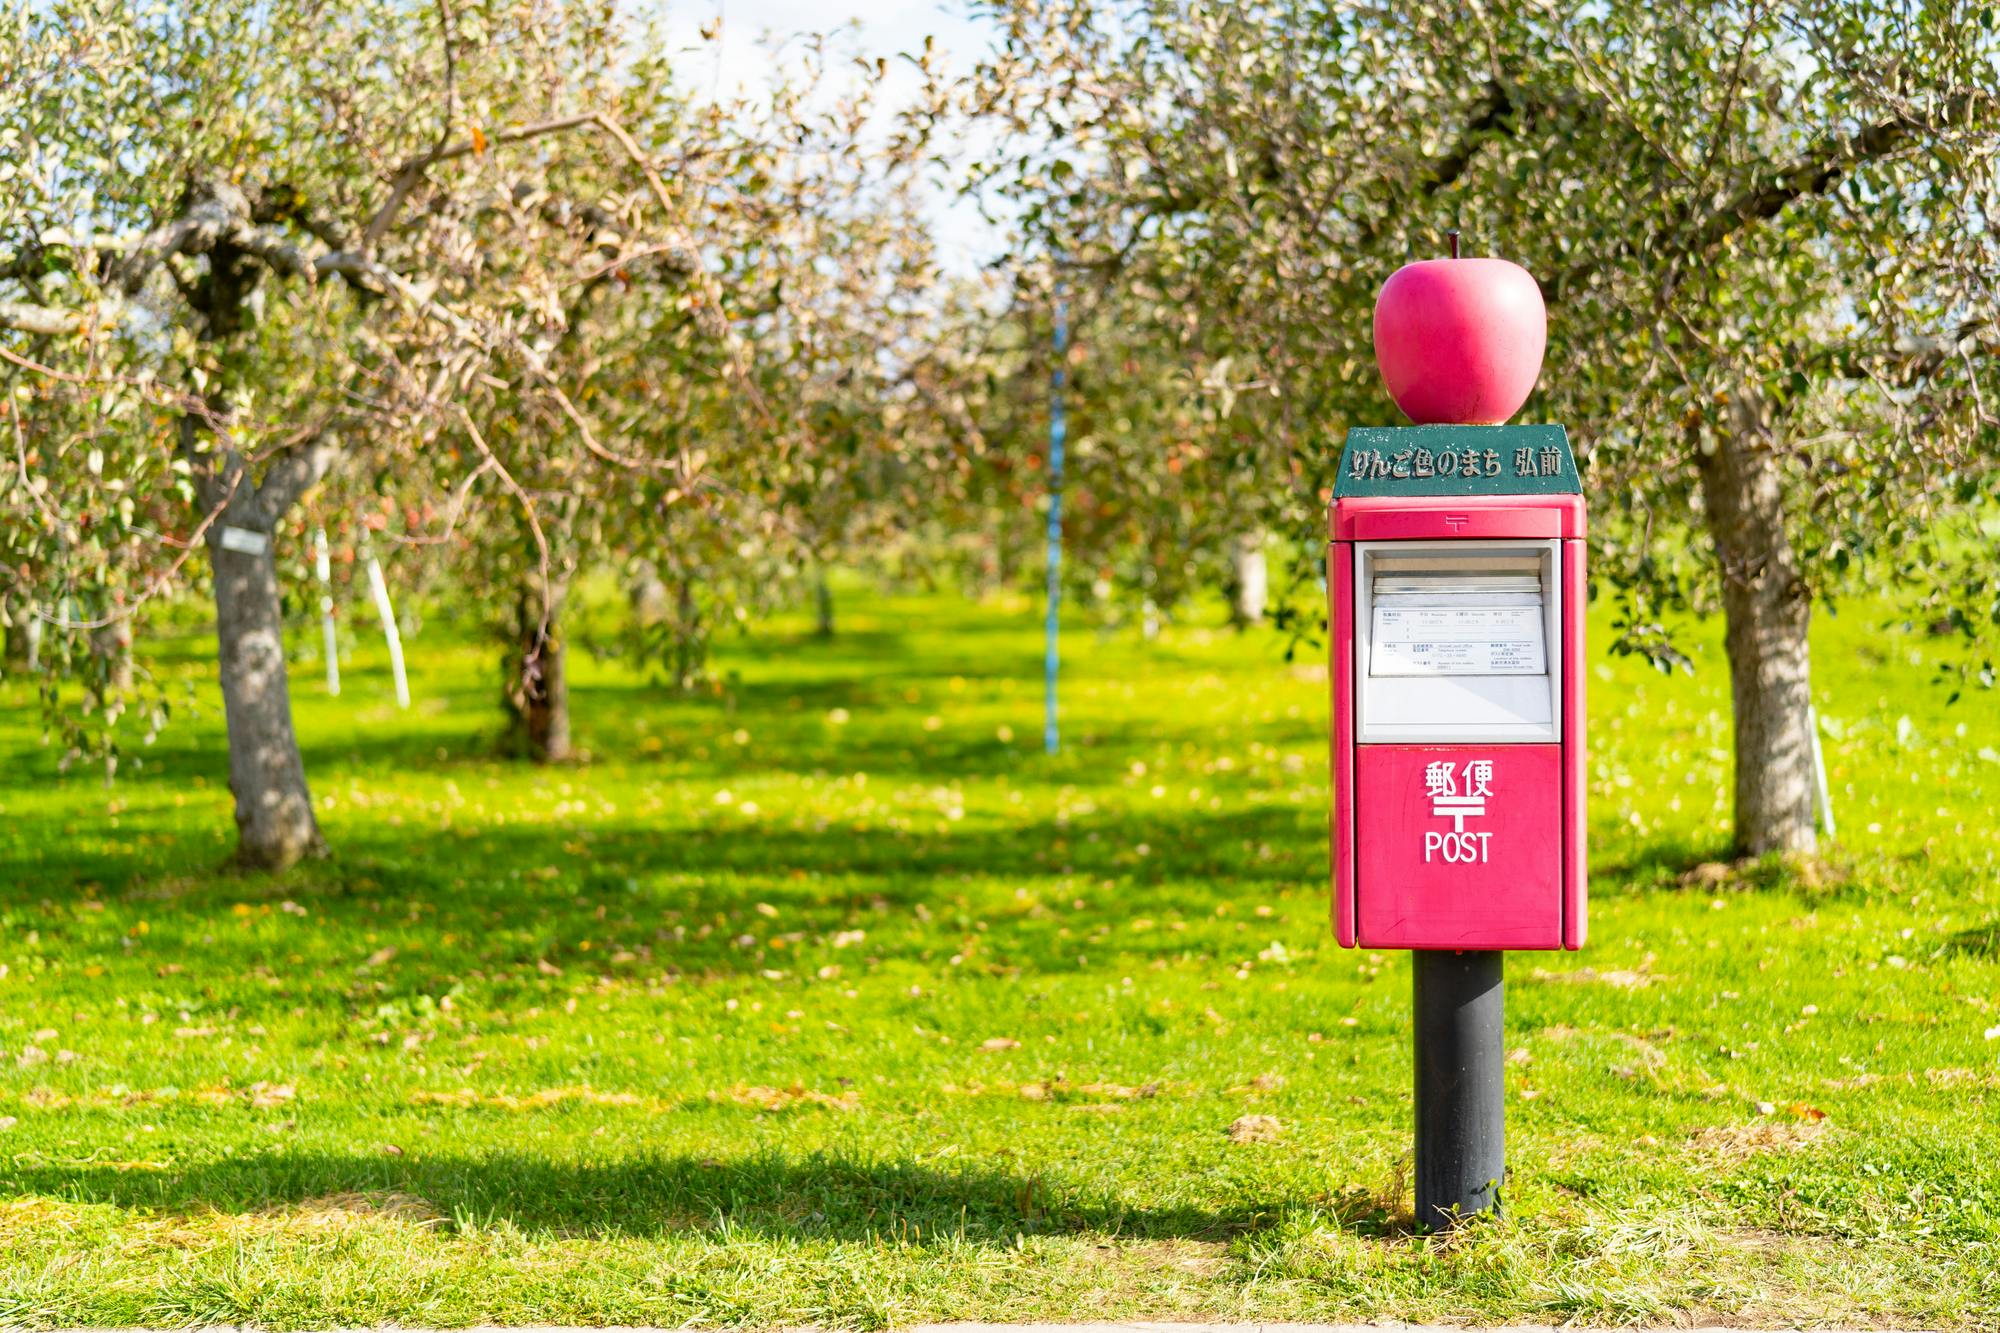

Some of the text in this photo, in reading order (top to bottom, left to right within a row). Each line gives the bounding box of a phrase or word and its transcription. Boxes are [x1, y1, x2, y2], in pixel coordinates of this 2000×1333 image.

[1350, 445, 1562, 478] りんご色のまち 弘前
[1425, 760, 1494, 797] 郵便
[1425, 832, 1493, 863] POST
